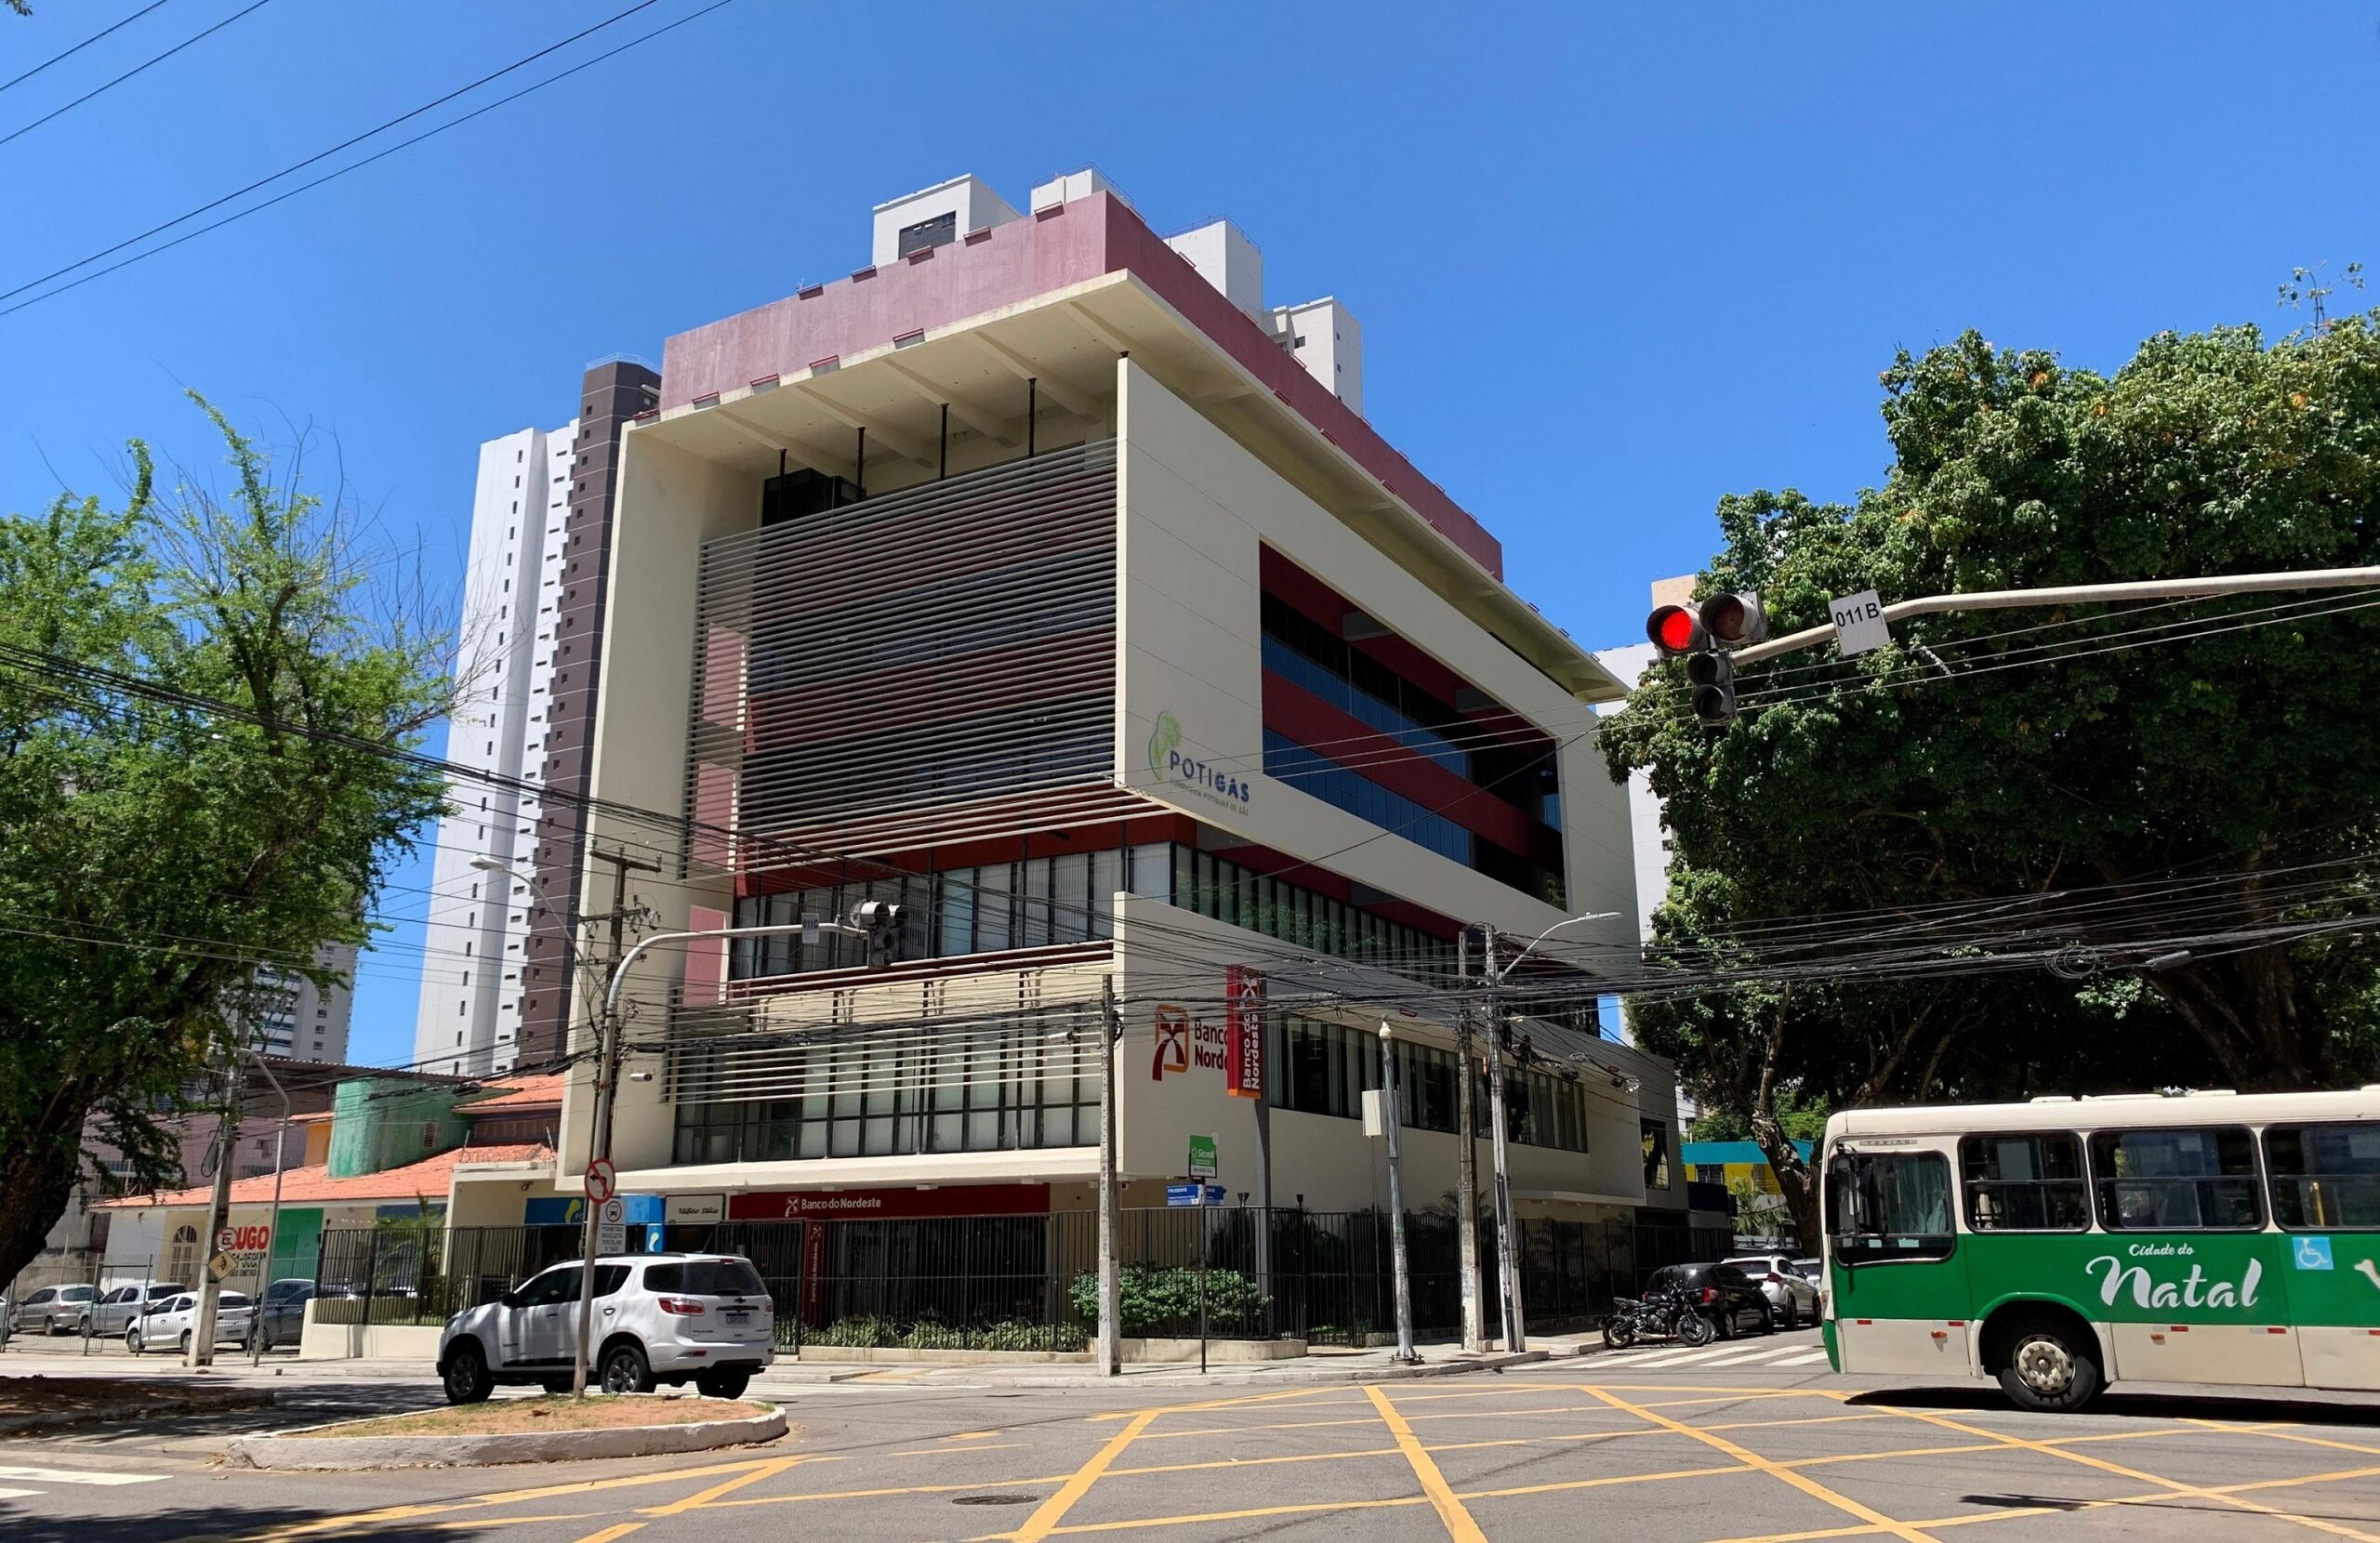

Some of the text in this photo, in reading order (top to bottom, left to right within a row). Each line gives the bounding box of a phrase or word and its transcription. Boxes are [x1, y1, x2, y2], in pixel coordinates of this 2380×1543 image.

[1203, 791, 1229, 809] POTIGUAR
[1230, 802, 1238, 812] DE
[1243, 1037, 1252, 1088] Banco
[1250, 1013, 1260, 1089] Nordeste
[801, 1197, 881, 1209] Banco do Nordeste
[2128, 1243, 2196, 1257] Cidade do
[2085, 1256, 2263, 1309] Natal
